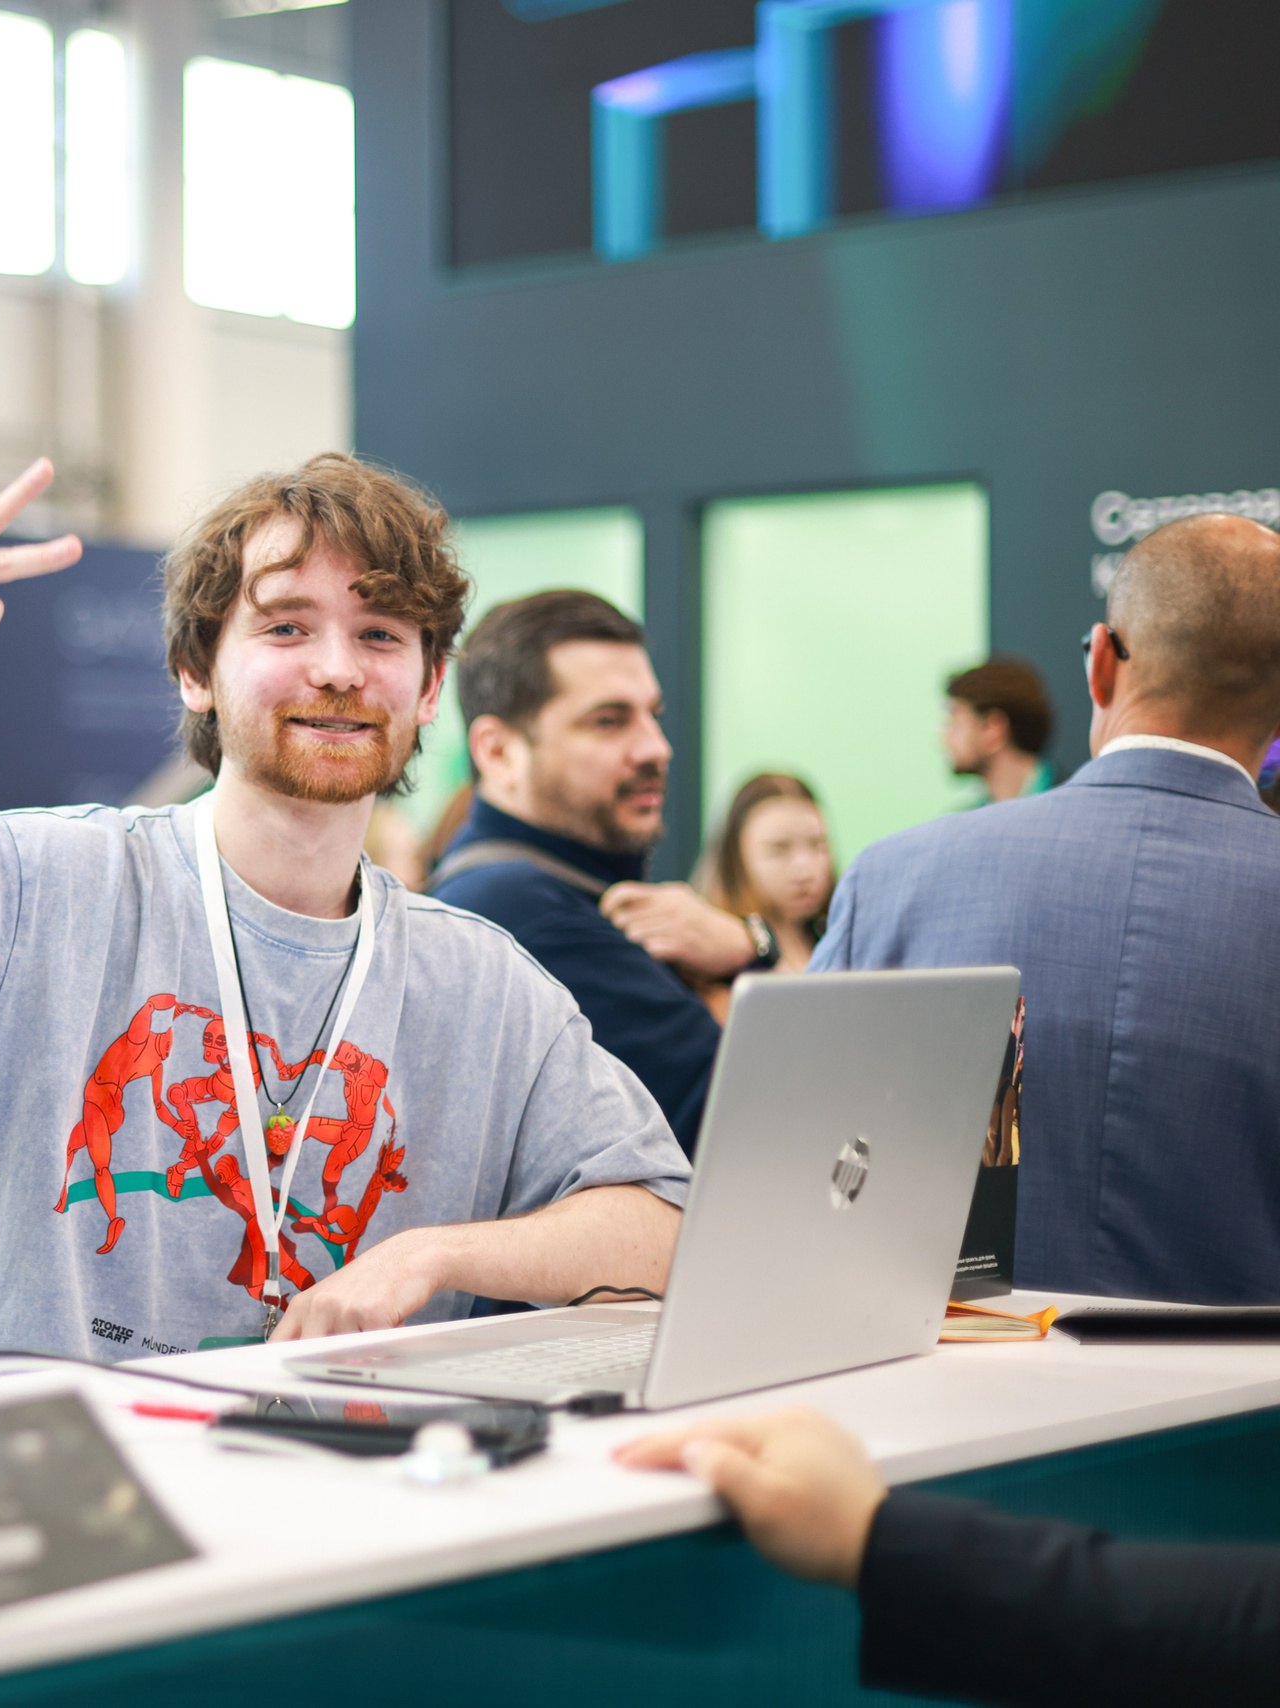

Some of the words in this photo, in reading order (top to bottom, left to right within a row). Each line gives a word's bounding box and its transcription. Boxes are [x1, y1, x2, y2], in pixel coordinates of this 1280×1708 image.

[91, 1318, 134, 1338] ATOMIC
[92, 1326, 129, 1344] HEART
[141, 1336, 192, 1355] MUNDFIS
